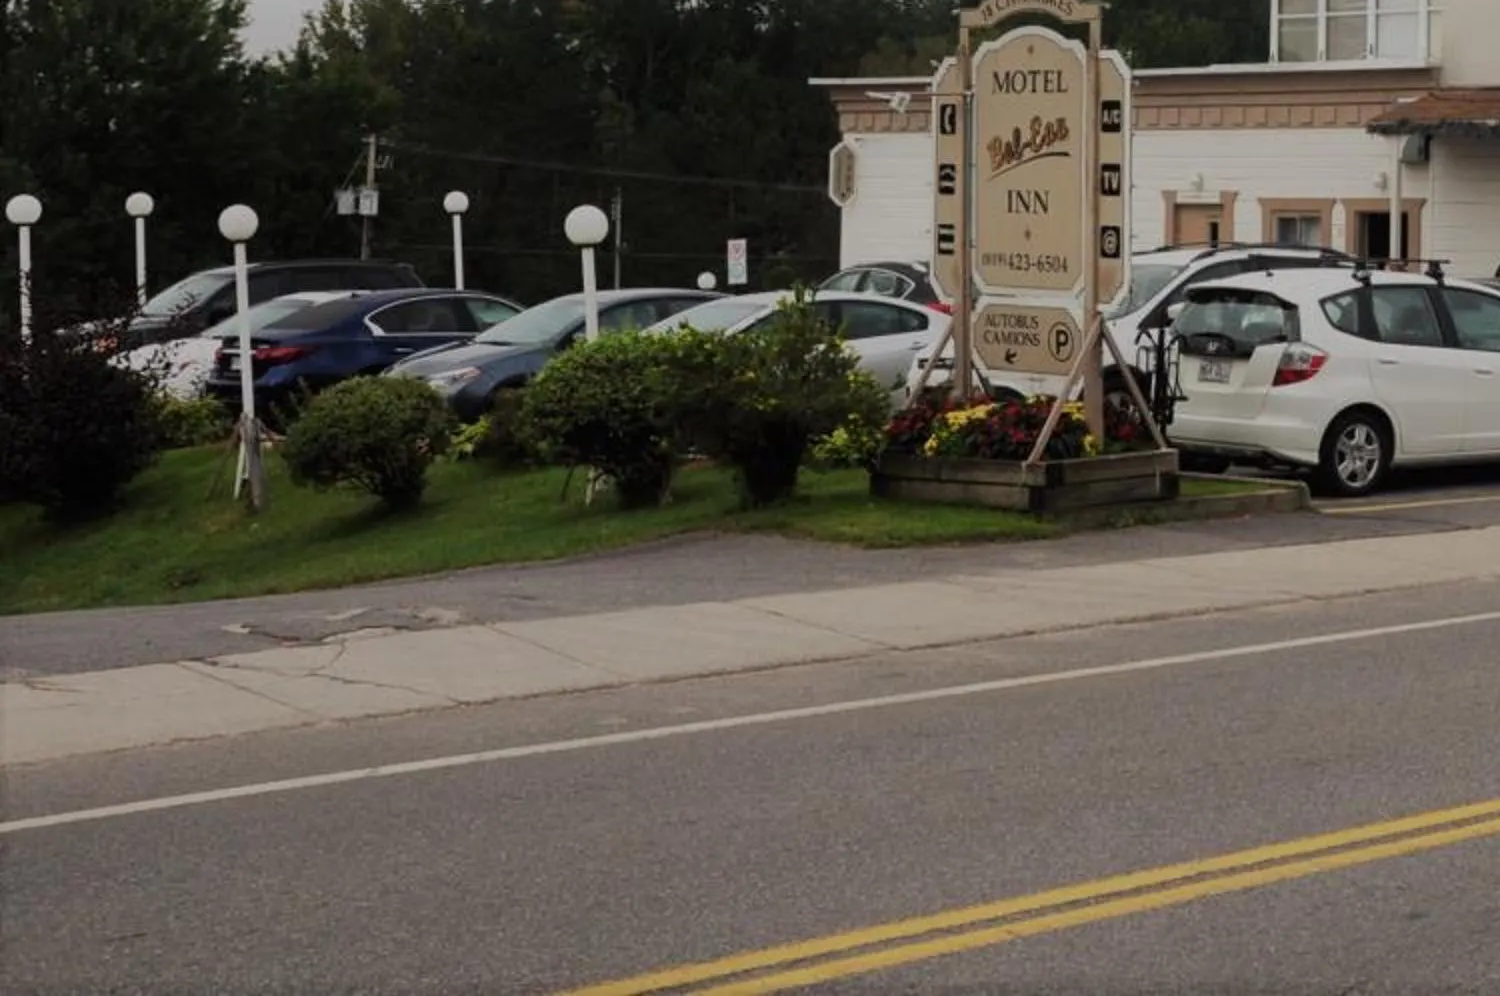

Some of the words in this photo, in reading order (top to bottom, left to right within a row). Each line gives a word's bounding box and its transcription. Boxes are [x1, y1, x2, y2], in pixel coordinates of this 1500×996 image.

[992, 69, 1068, 95] MOTEL
[1103, 171, 1119, 190] TV
[1007, 189, 1050, 215] INN
[984, 313, 1040, 329] AUTOBUS
[983, 329, 1041, 347] CAMIONS
[1055, 329, 1069, 355] P
